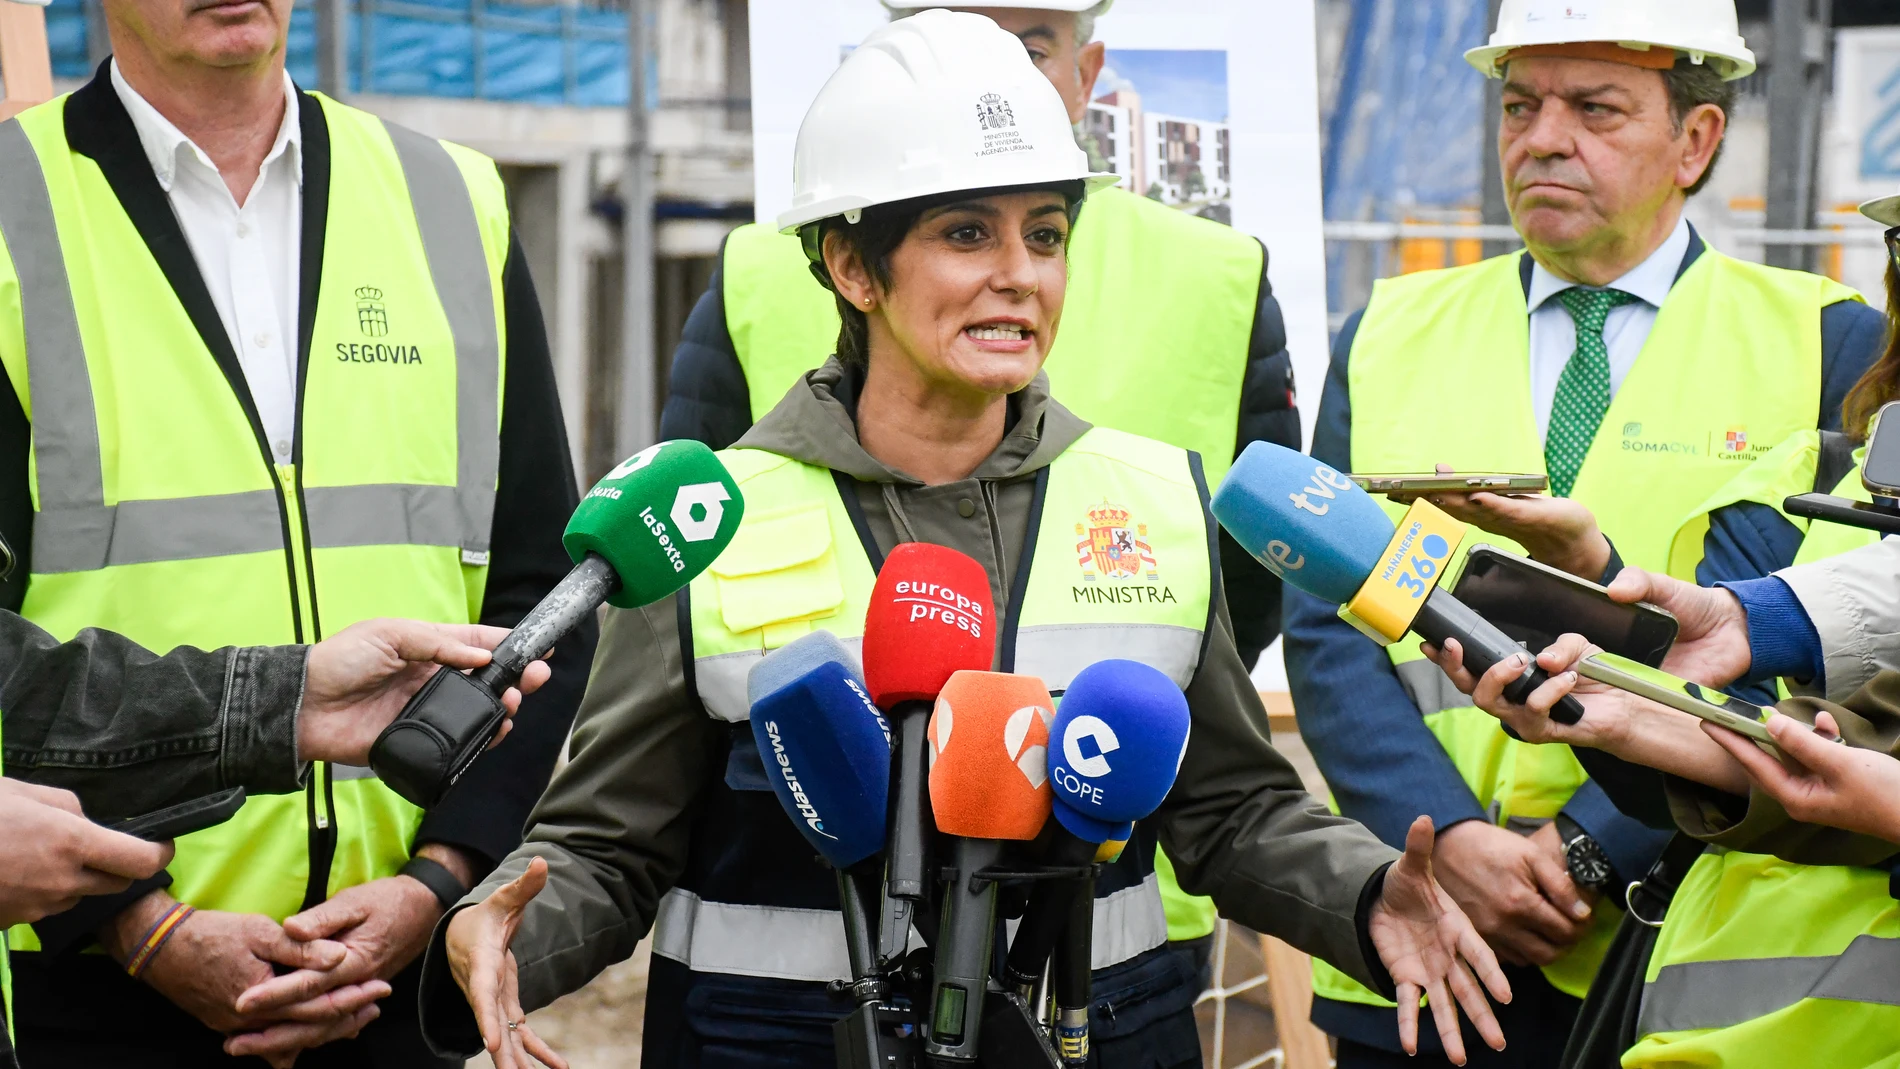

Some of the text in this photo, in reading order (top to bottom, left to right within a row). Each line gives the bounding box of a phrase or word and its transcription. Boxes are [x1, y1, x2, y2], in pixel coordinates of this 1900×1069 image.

[981, 146, 1009, 156] AGENDA
[984, 131, 1019, 141] MINISTERIO
[995, 138, 1023, 146] VIVIENDA
[336, 343, 422, 365] SEGOVIA
[1622, 439, 1699, 455] SOMACYL
[1718, 453, 1757, 461] Castilla
[1289, 465, 1352, 516] tve
[639, 506, 686, 573] laSexta
[1382, 521, 1423, 581] MAÑANEROS
[1256, 539, 1305, 576] ve
[1396, 534, 1449, 599] 360
[896, 581, 983, 616] europa
[1072, 586, 1177, 603] MINISTRA
[909, 604, 981, 638] press
[1054, 766, 1104, 805] COPE
